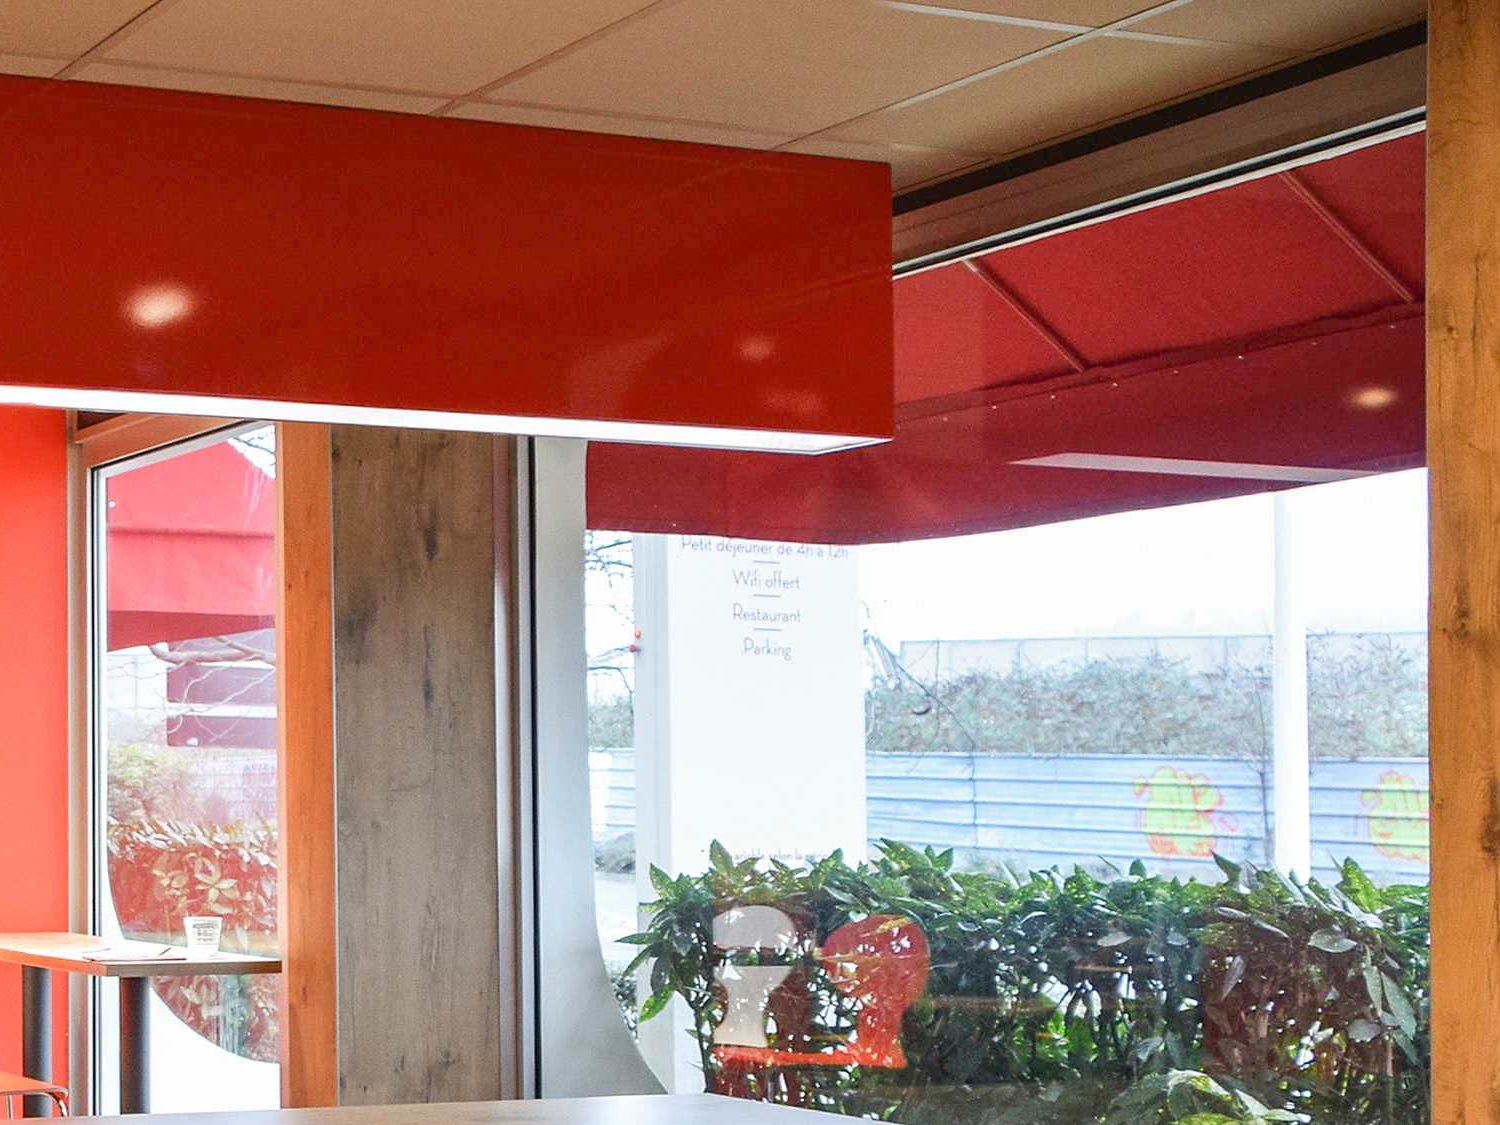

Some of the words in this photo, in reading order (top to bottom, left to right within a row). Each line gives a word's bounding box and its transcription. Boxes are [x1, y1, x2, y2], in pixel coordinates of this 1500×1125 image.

[681, 535, 712, 551] Petit
[776, 543, 793, 555] de
[732, 568, 762, 587] Wifi
[765, 570, 801, 589] offert
[732, 601, 801, 623] Restaurant
[744, 636, 792, 662] Parking
